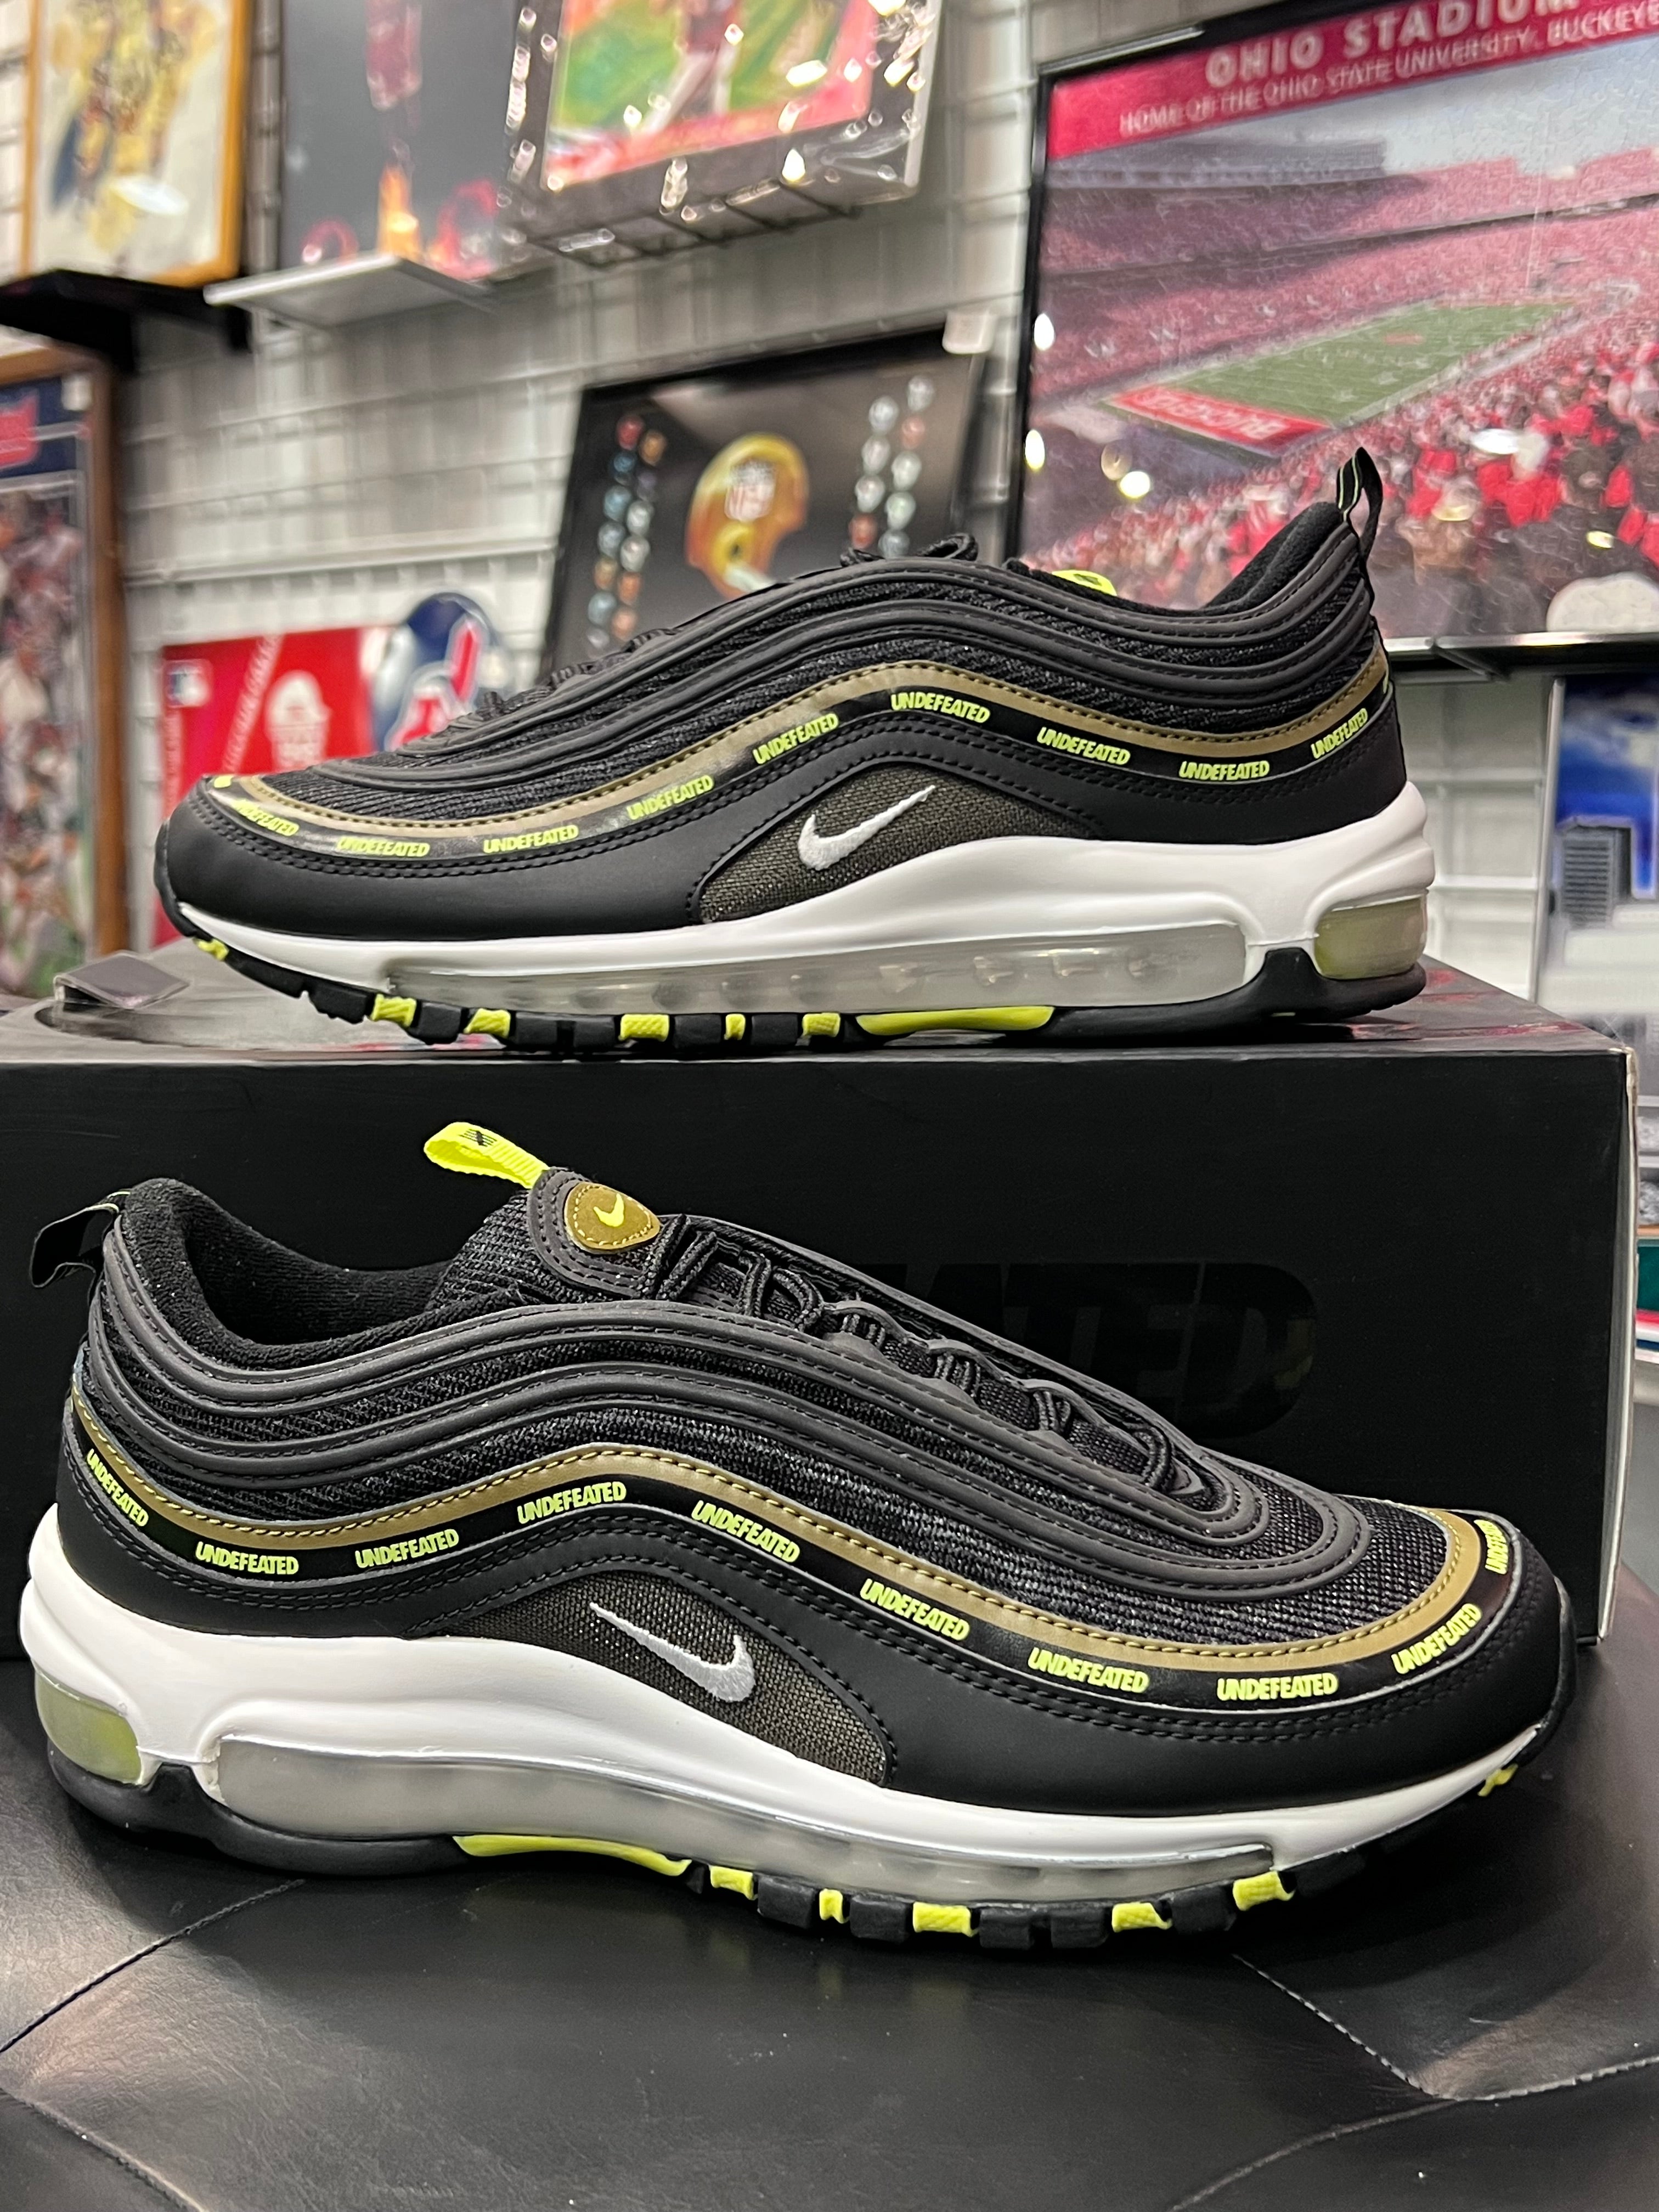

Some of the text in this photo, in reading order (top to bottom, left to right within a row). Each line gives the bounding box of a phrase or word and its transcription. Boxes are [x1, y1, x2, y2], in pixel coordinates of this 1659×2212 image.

[1205, 30, 1324, 88] OHIO
[1119, 102, 1185, 137] HOME
[1186, 95, 1216, 122] OF
[1221, 87, 1263, 114] THE
[1263, 73, 1324, 106] OHIO
[1325, 58, 1395, 94] STATE
[890, 692, 990, 724] UNDEFEATED
[752, 713, 839, 765] UNDEFEATED
[1037, 726, 1131, 765] UNDEFEATED
[1311, 707, 1368, 759] UNDEFEATED
[1178, 760, 1270, 782] UNDEFEATED
[627, 774, 714, 820] UNDEFEATED
[336, 836, 431, 857] UNDEFEATED
[483, 825, 579, 854] UNDEFEATED
[86, 1448, 149, 1527] UNDEFEATED
[517, 1481, 627, 1525] UNDEFEATED
[355, 1528, 460, 1569] UNDEFEATED
[691, 1500, 800, 1564] UNDEFEATED
[196, 1541, 299, 1575] UNDEFEATED
[860, 1578, 970, 1642] UNDEFEATED
[1391, 1602, 1482, 1674] UNDEFEATED
[1027, 1647, 1150, 1694] UNDEFEATED
[1217, 1672, 1339, 1701] UNDEFEATED
